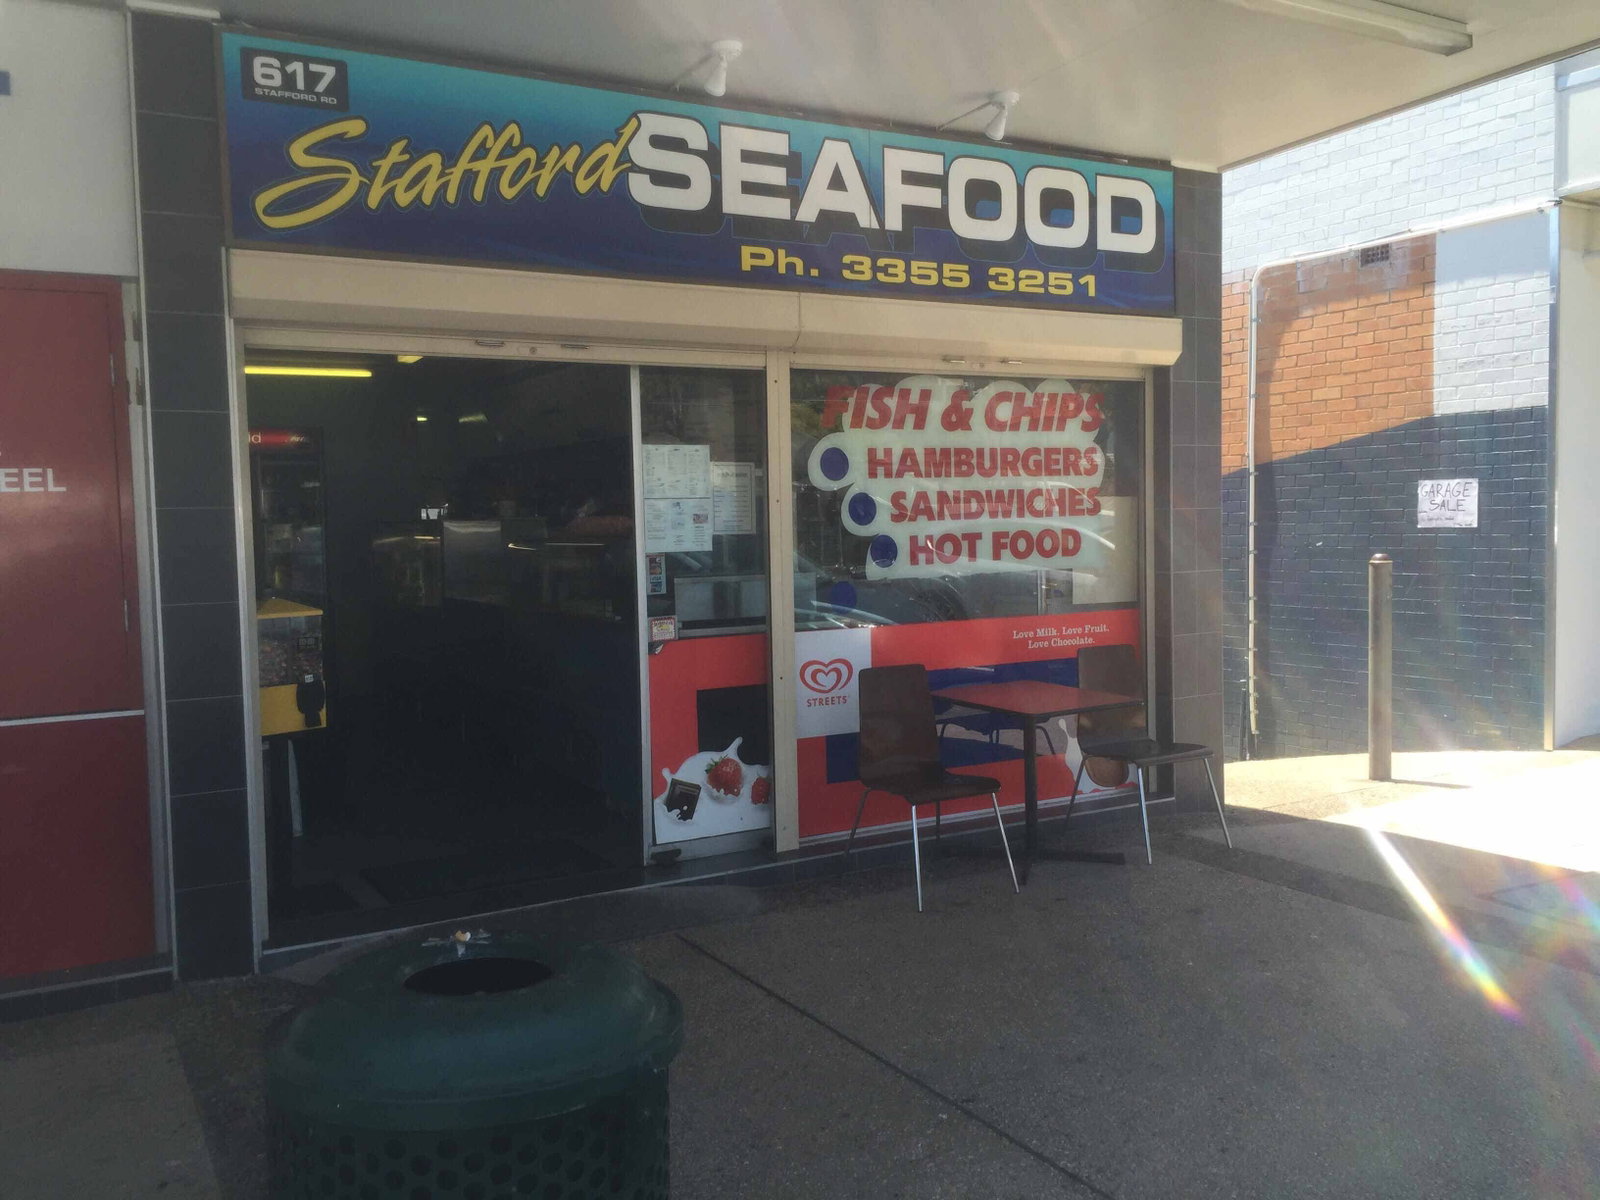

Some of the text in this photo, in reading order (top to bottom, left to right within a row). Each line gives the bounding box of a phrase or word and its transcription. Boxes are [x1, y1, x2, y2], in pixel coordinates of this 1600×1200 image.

[253, 56, 336, 92] 617
[254, 87, 337, 105] STAFFORD RD
[255, 112, 1157, 254] Stafford SEAFOOD
[740, 245, 1097, 298] Ph. 3355 3251
[819, 385, 1105, 433] FISH & CHIPS
[867, 446, 1099, 479] HAMBURGERS
[0, 467, 67, 492] EEL
[1421, 482, 1472, 498] GARAGE
[889, 487, 1102, 523] SANDWICHES
[1428, 499, 1466, 512] SALE
[909, 528, 1082, 566] HOT FOOD
[1013, 630, 1034, 639] Love
[1062, 625, 1082, 634] Love
[1084, 624, 1110, 633] Fruit.
[1028, 636, 1095, 648] Love Chocolate.
[806, 695, 848, 708] STREETS
